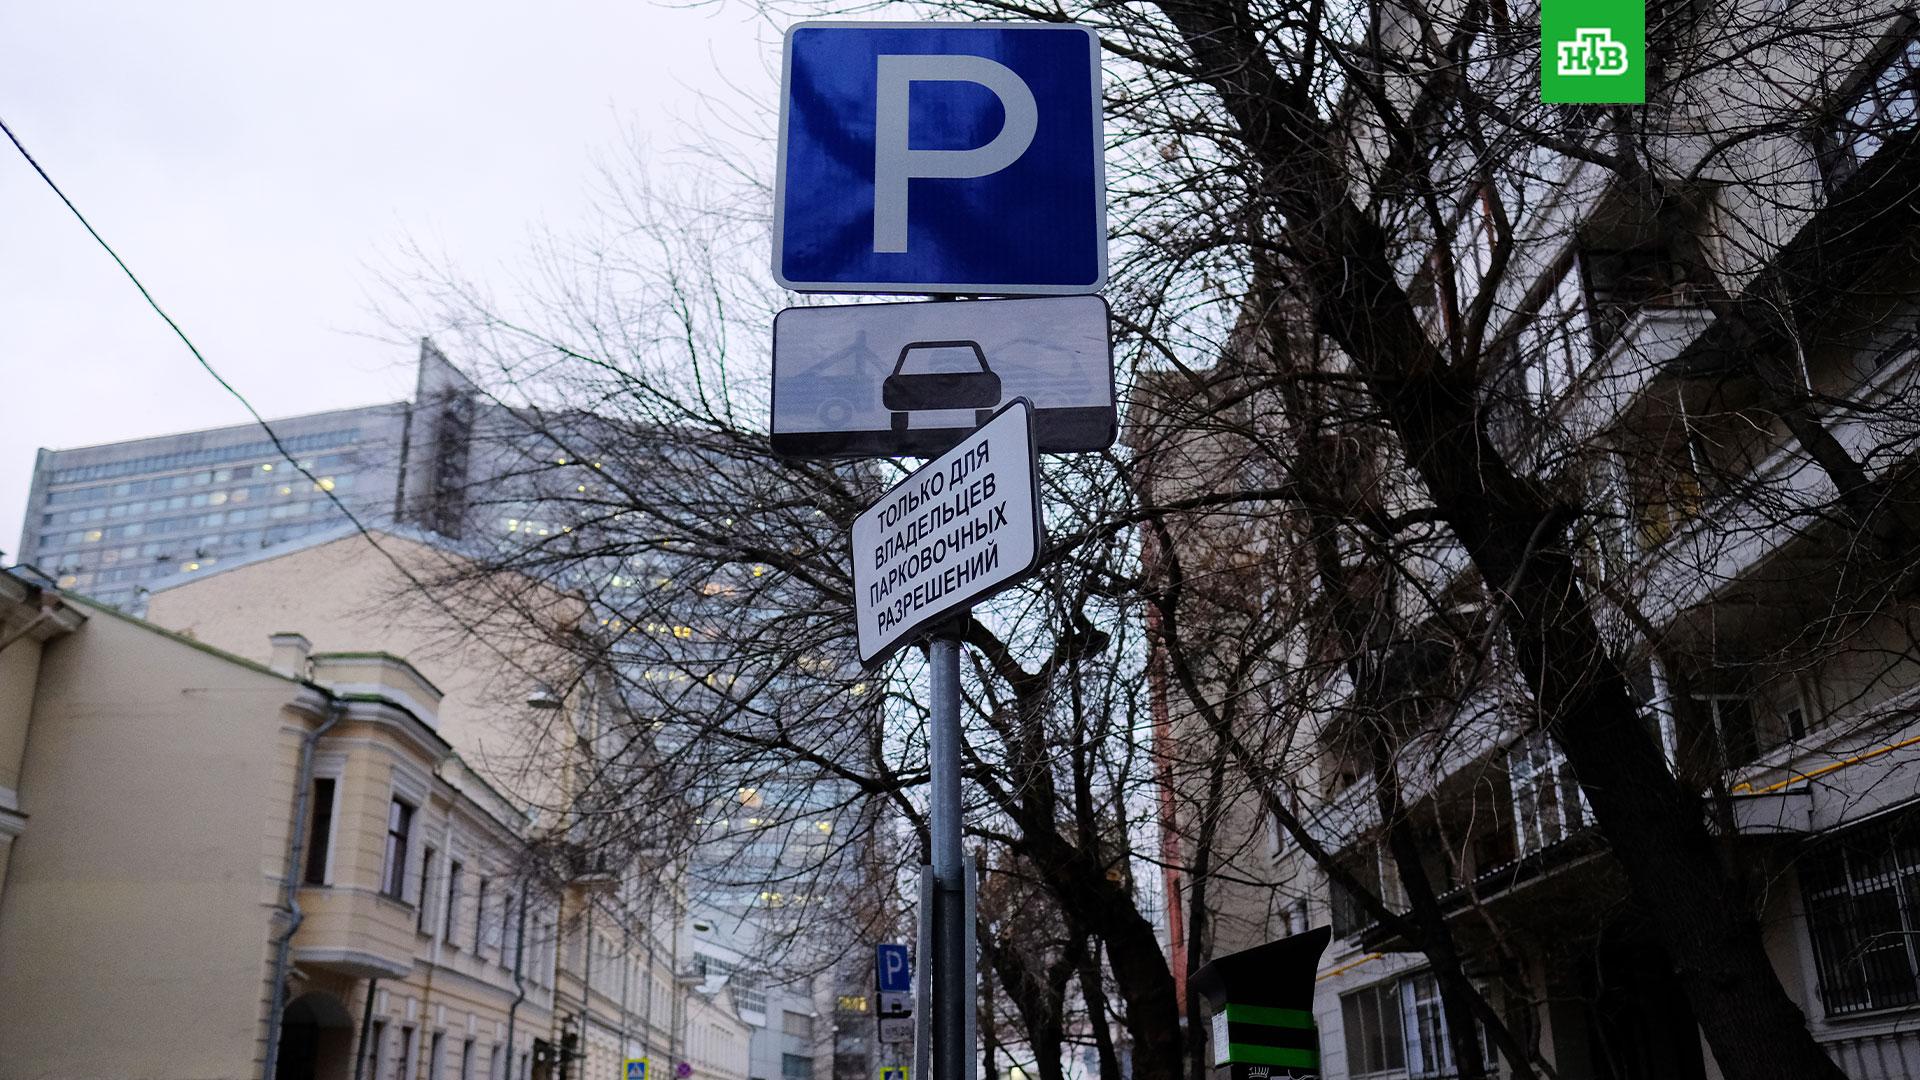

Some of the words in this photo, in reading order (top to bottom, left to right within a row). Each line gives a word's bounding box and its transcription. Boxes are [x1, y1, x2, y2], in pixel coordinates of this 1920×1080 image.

[873, 54, 1038, 253] P
[875, 472, 996, 570] ВЛАДЕЛЬЦЕВ
[877, 471, 944, 534] ТОЛЬКО
[949, 439, 989, 491] ДЛЯ
[870, 501, 1008, 607] ПАРКОВОЧНЫХ
[877, 540, 999, 636] РАЗРЕШЕНИЙ
[885, 950, 903, 985] P
